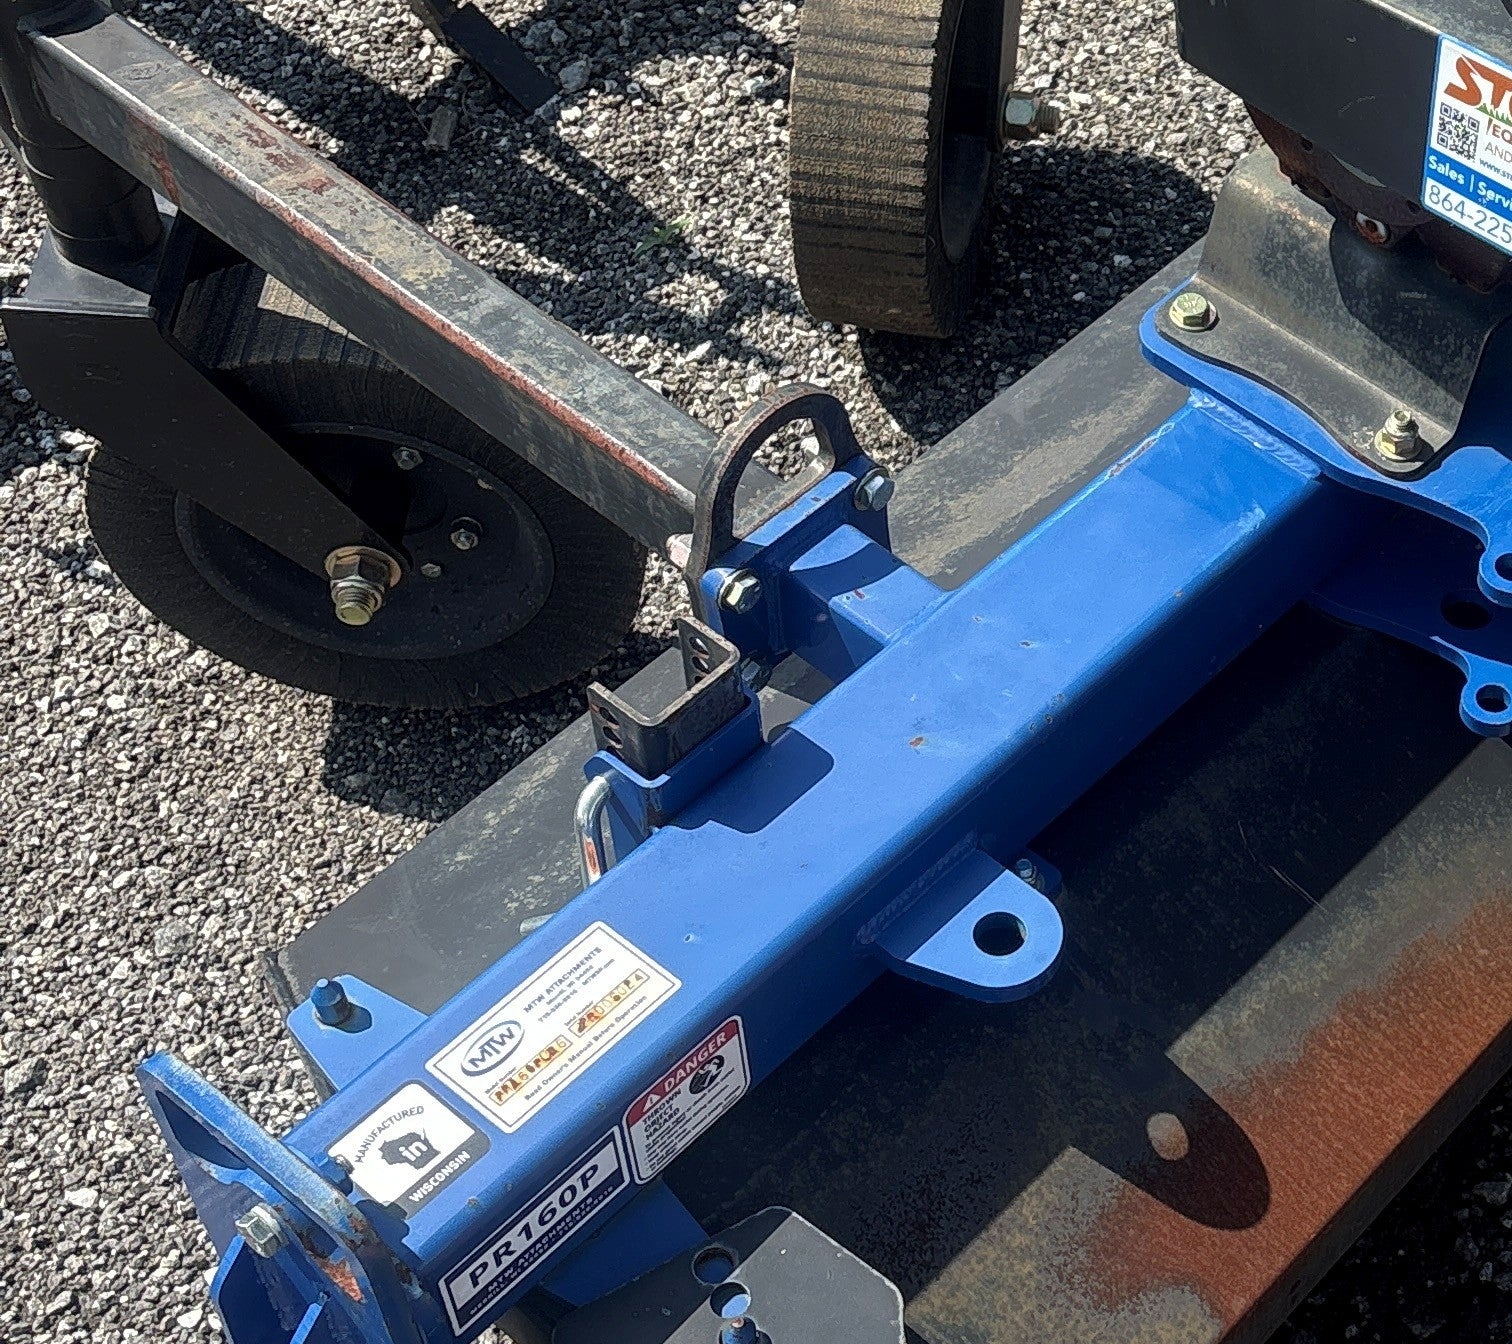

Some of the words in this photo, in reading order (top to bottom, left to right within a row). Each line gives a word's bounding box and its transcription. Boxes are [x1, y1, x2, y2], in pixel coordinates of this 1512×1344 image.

[1428, 156, 1465, 185] Sales
[523, 994, 545, 1014] MTW
[545, 946, 603, 997] ATTACHMENTS
[468, 1027, 516, 1069] MTW
[568, 1042, 593, 1063] Manual
[593, 1022, 616, 1042] Before
[614, 995, 648, 1022] Operation
[663, 1030, 727, 1094] DANGER
[354, 1103, 425, 1165] MANUFACTURED
[642, 1088, 682, 1124] THROWN
[398, 1140, 429, 1165] in
[408, 1150, 472, 1203] WISCONSIN
[469, 1163, 599, 1289] PR160P
